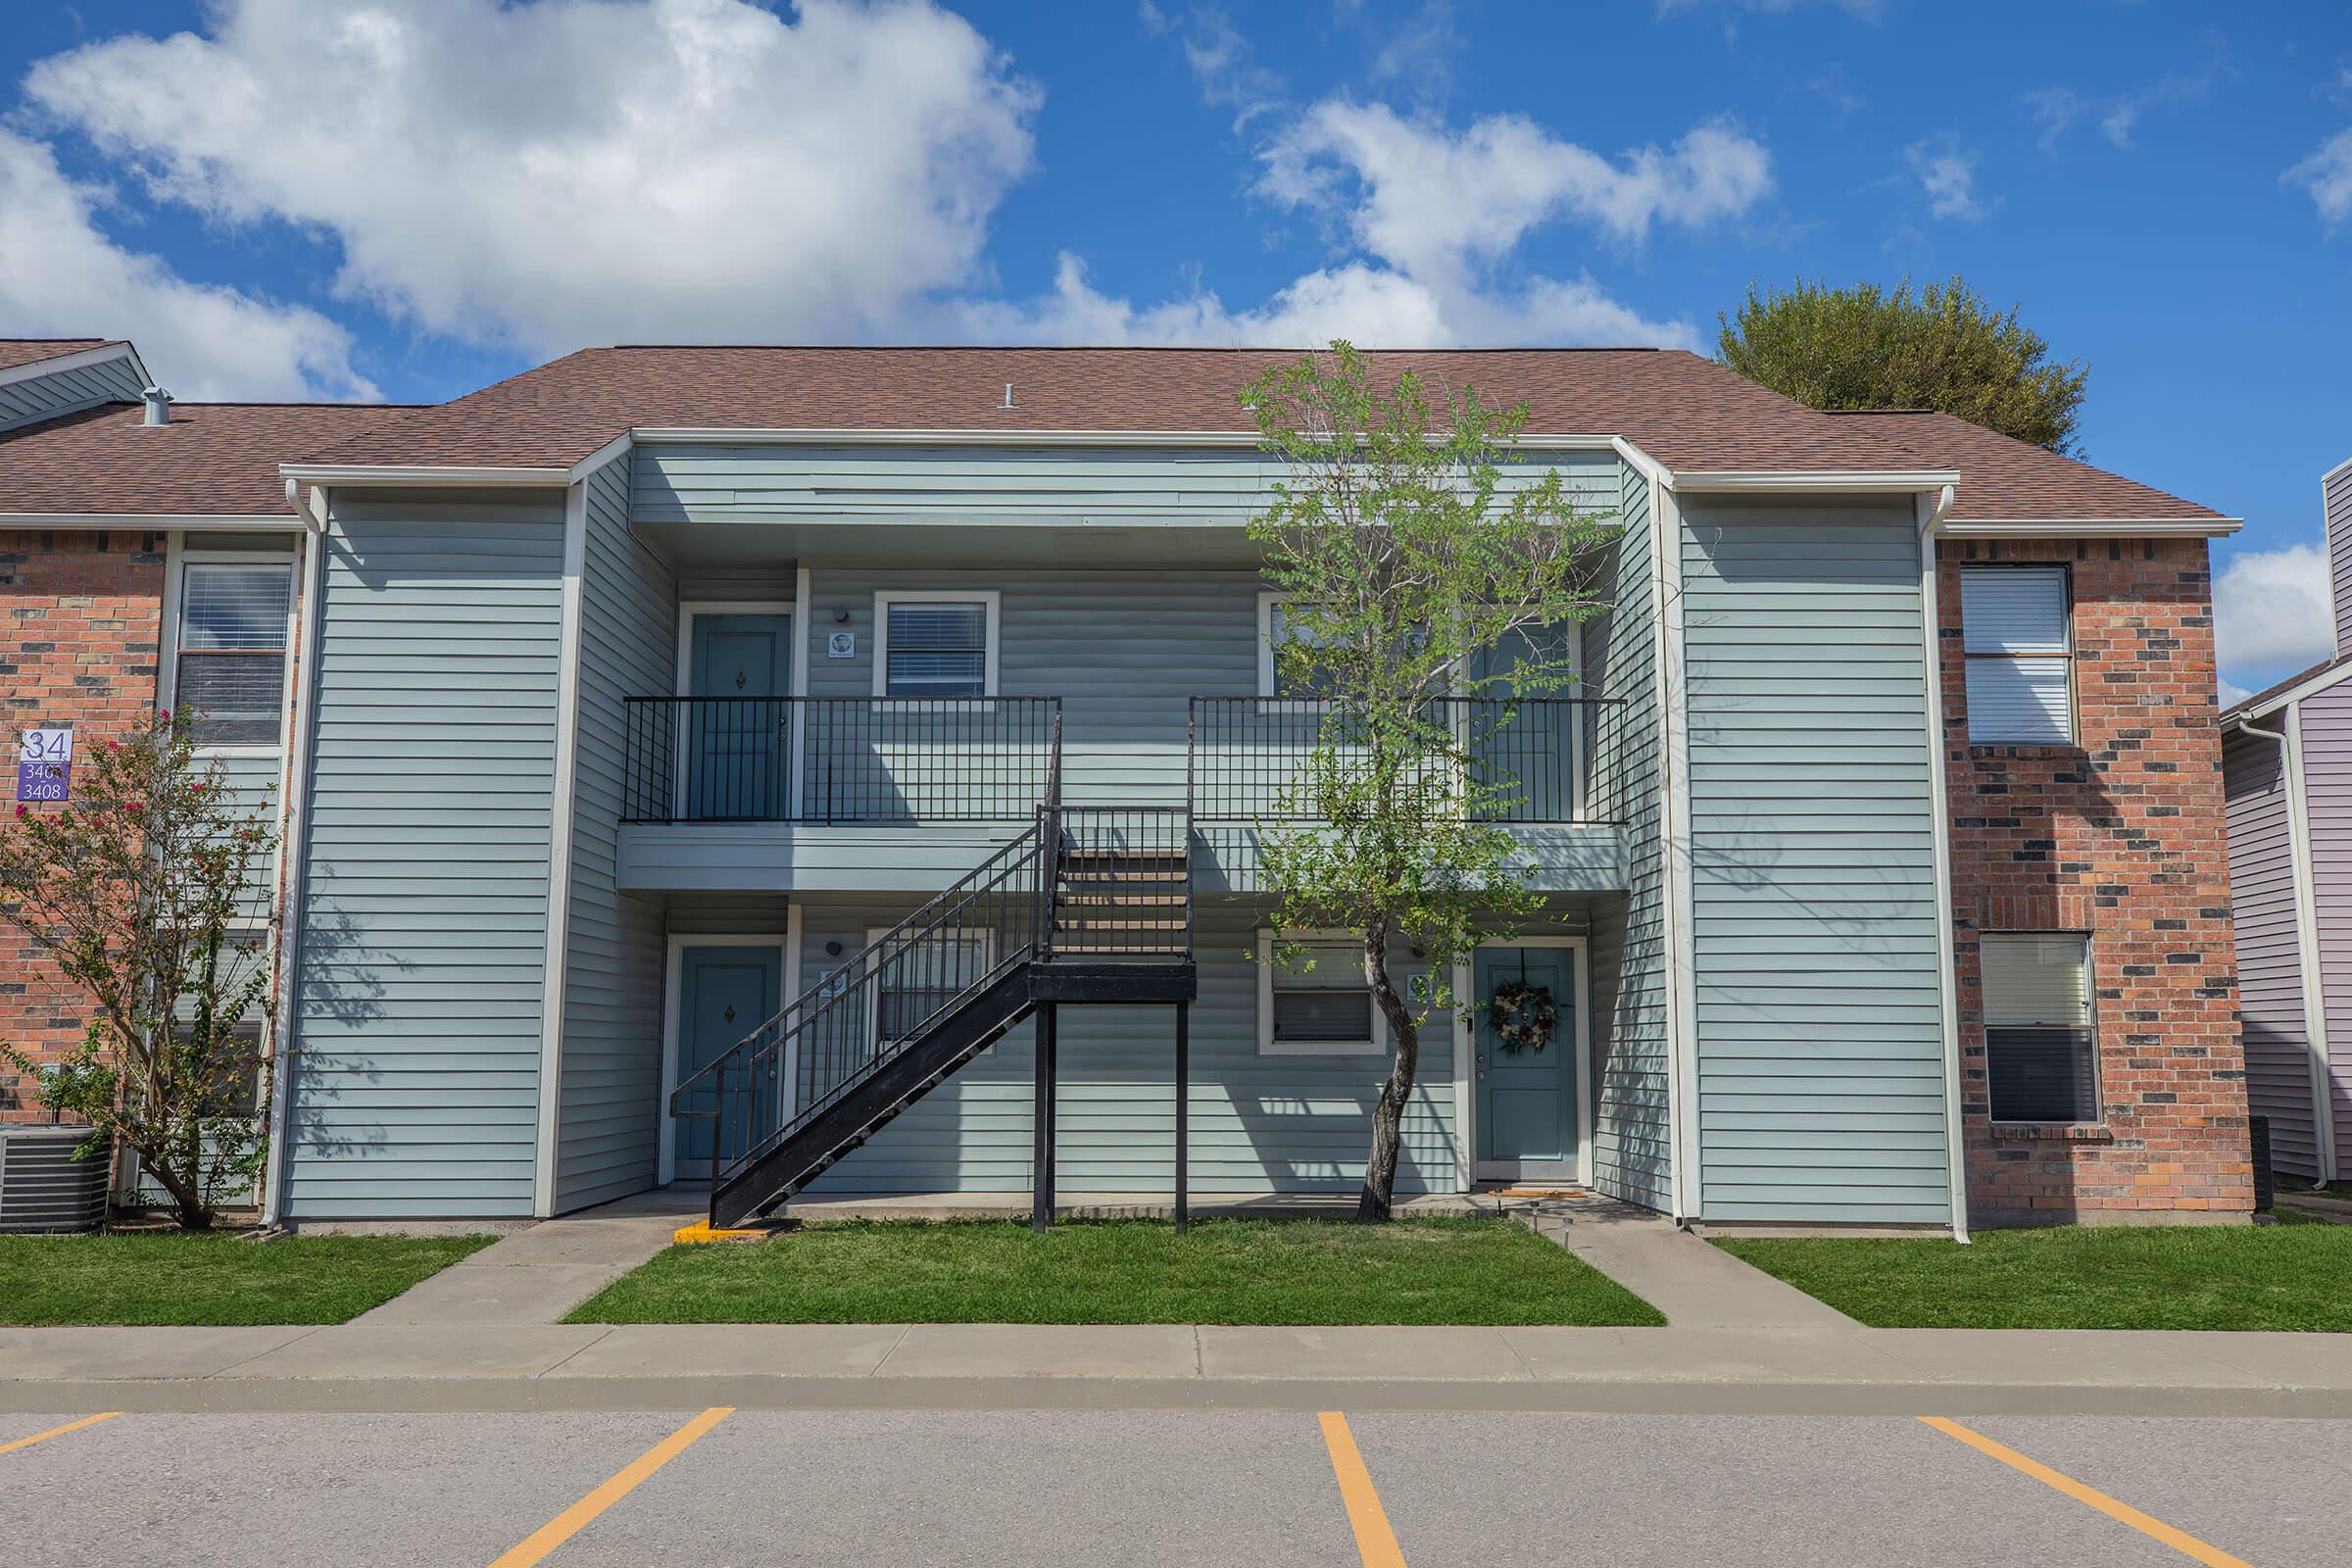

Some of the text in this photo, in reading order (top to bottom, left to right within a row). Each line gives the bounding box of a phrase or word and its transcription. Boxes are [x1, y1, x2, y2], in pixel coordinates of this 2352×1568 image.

[26, 732, 66, 759] 34
[25, 764, 61, 779] 340
[24, 784, 61, 799] 3408
